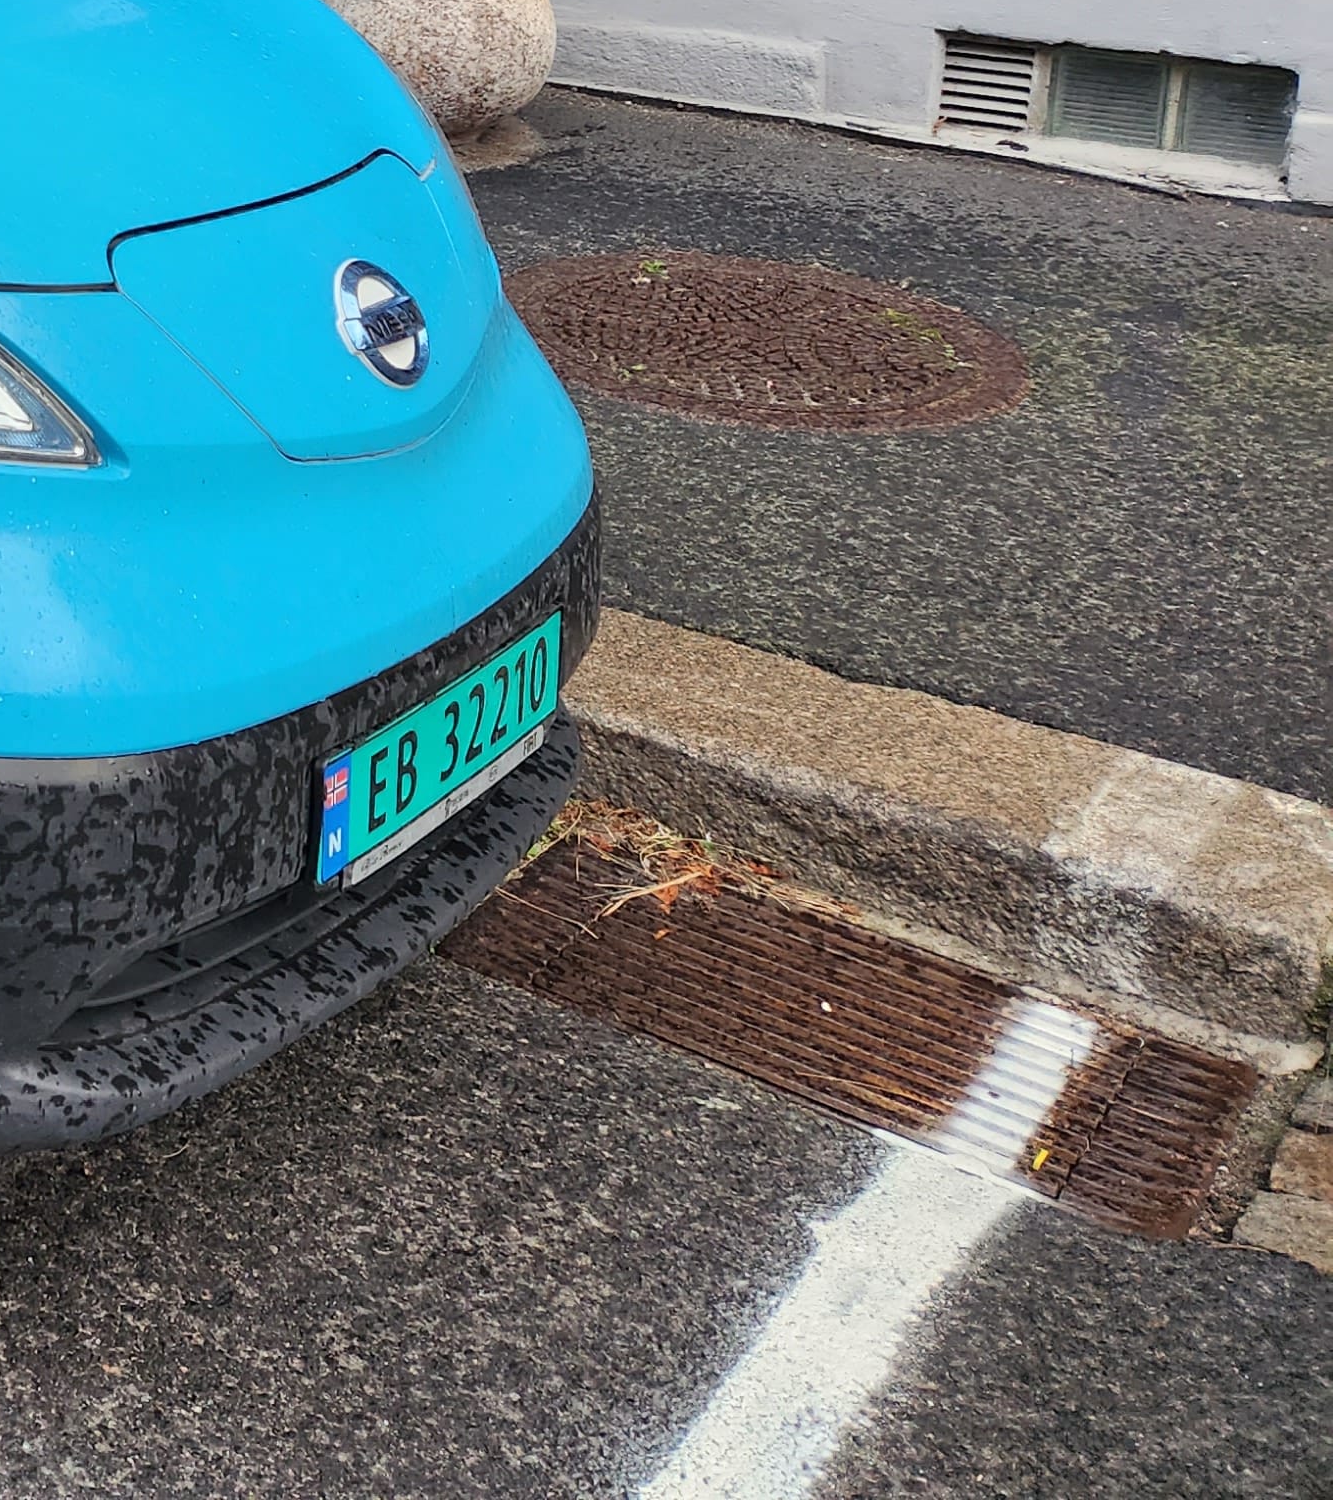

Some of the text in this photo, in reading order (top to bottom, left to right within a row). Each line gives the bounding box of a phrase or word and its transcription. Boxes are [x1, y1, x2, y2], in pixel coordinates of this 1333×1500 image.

[367, 635, 548, 834] EB 32210
[328, 827, 342, 858] N
